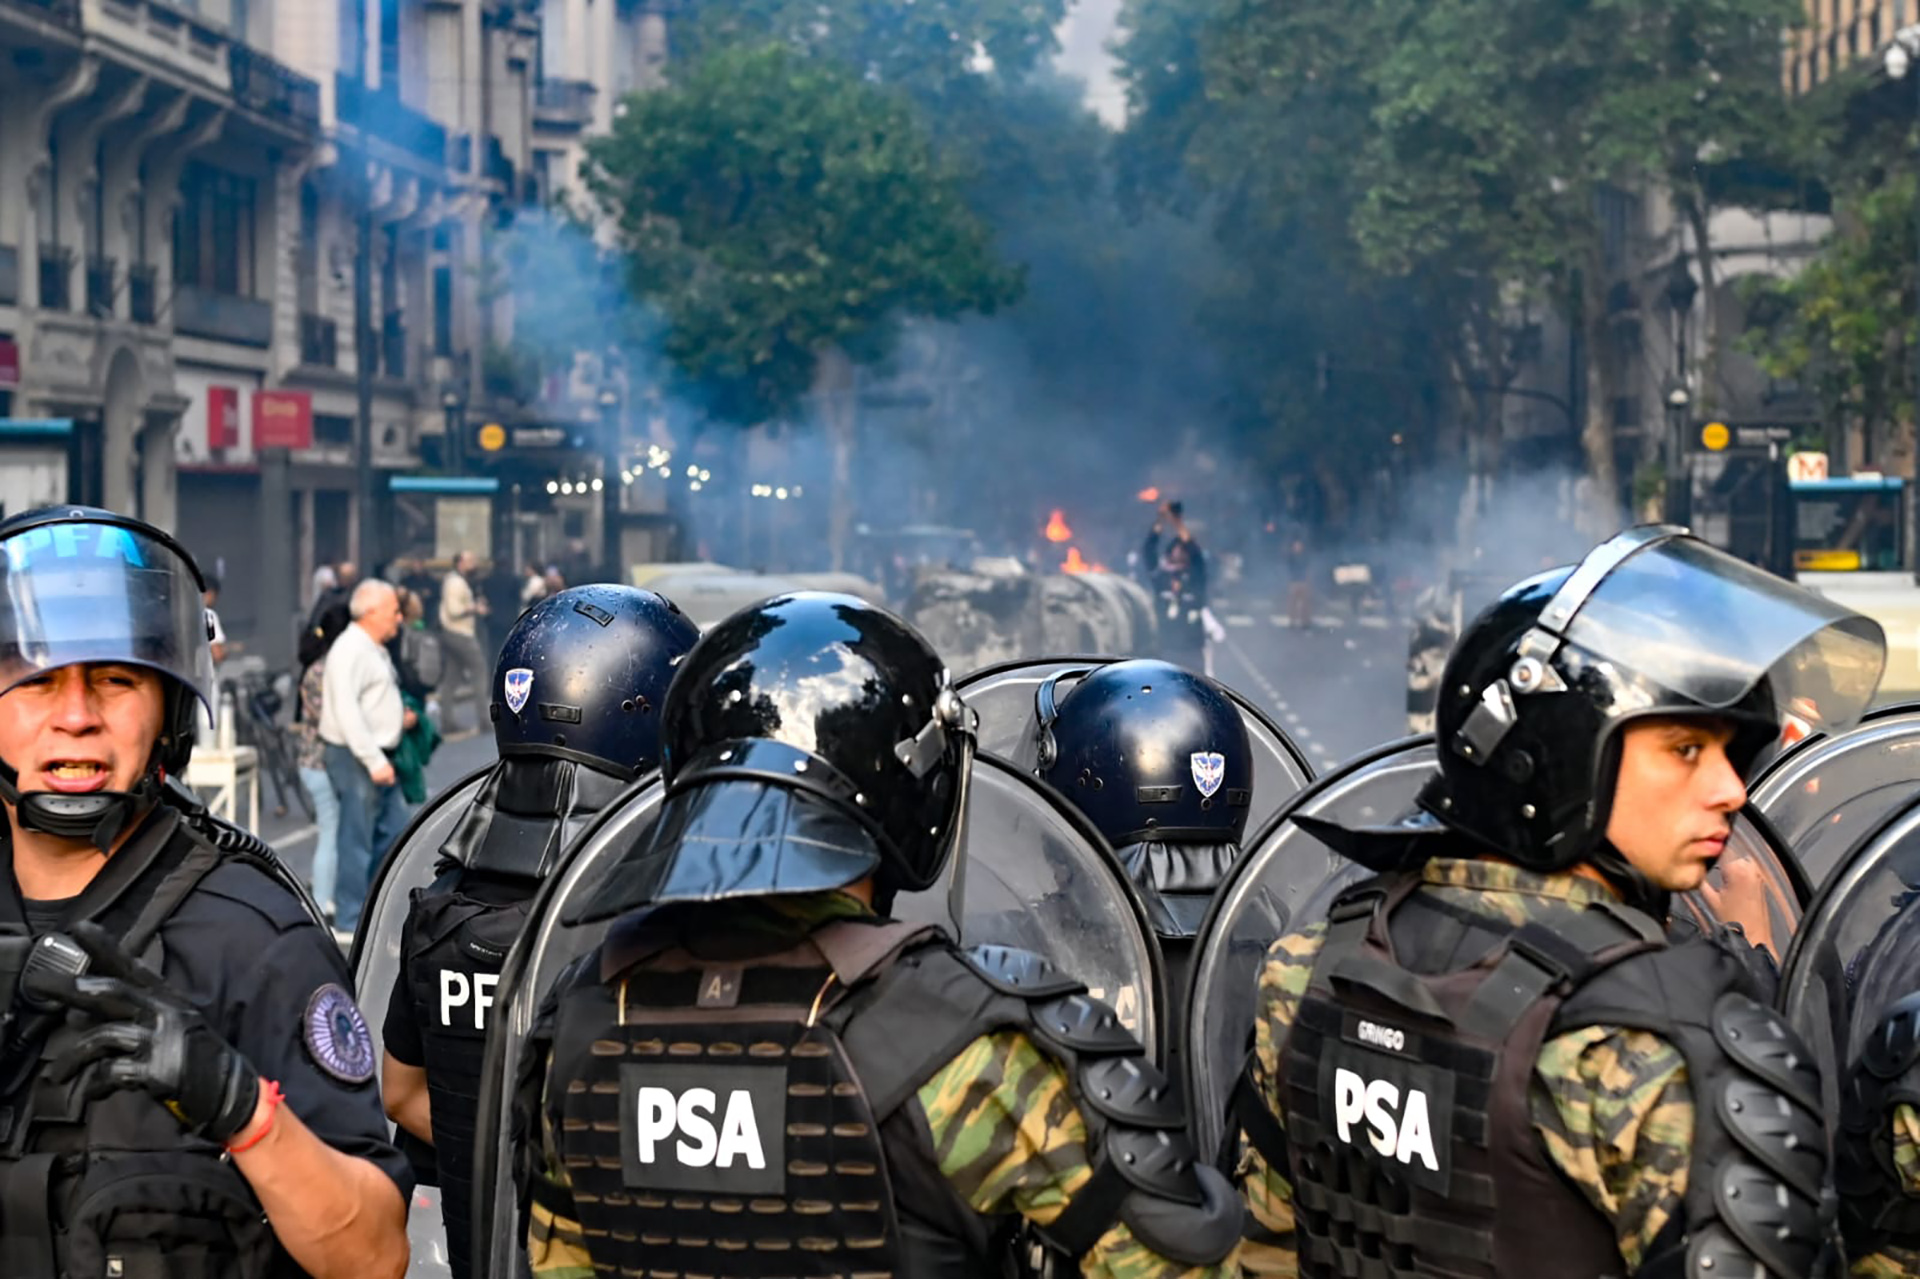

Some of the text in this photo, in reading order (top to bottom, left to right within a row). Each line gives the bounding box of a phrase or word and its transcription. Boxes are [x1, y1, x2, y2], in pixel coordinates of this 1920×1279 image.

[6, 524, 144, 571] PFA
[440, 969, 500, 1030] PF
[637, 1086, 766, 1169] PSA
[1335, 1067, 1439, 1171] PSA
